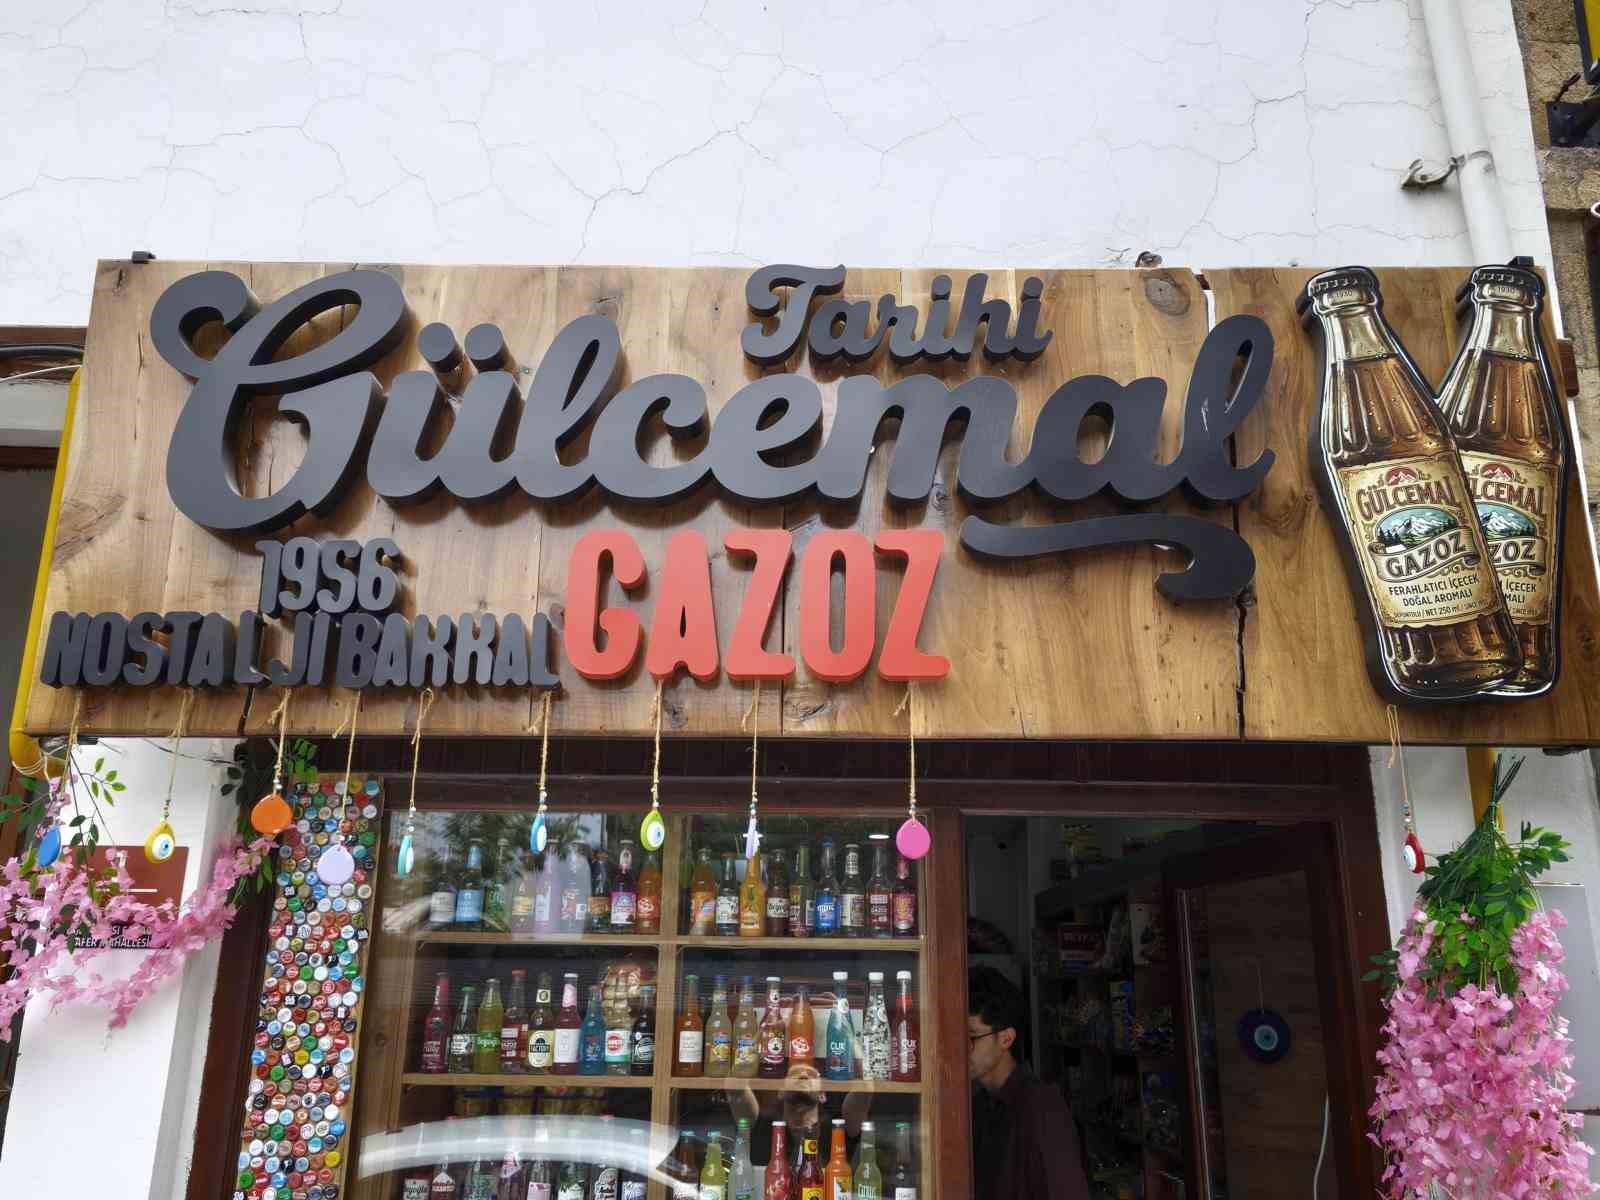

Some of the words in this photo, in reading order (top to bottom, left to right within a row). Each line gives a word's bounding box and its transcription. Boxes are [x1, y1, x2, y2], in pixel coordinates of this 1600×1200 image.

[740, 264, 1053, 363] Tarihi
[150, 270, 1275, 532] Gülcemal
[1356, 475, 1460, 521] GÜLCEMAL
[1471, 479, 1547, 516] LCEMAL
[1386, 531, 1465, 577] GAZOZ
[1487, 541, 1536, 562] ZOZ
[255, 537, 402, 616] 1956
[1388, 580, 1448, 597] FERAHLATICI
[1448, 573, 1480, 590] İÇECEK
[1402, 595, 1433, 607] DOĞAL
[1434, 588, 1473, 604] AROMALI
[1503, 593, 1525, 604] MALI
[564, 528, 951, 682] GAZOZ
[337, 612, 562, 690] BAKKAL
[74, 936, 97, 948] AFER
